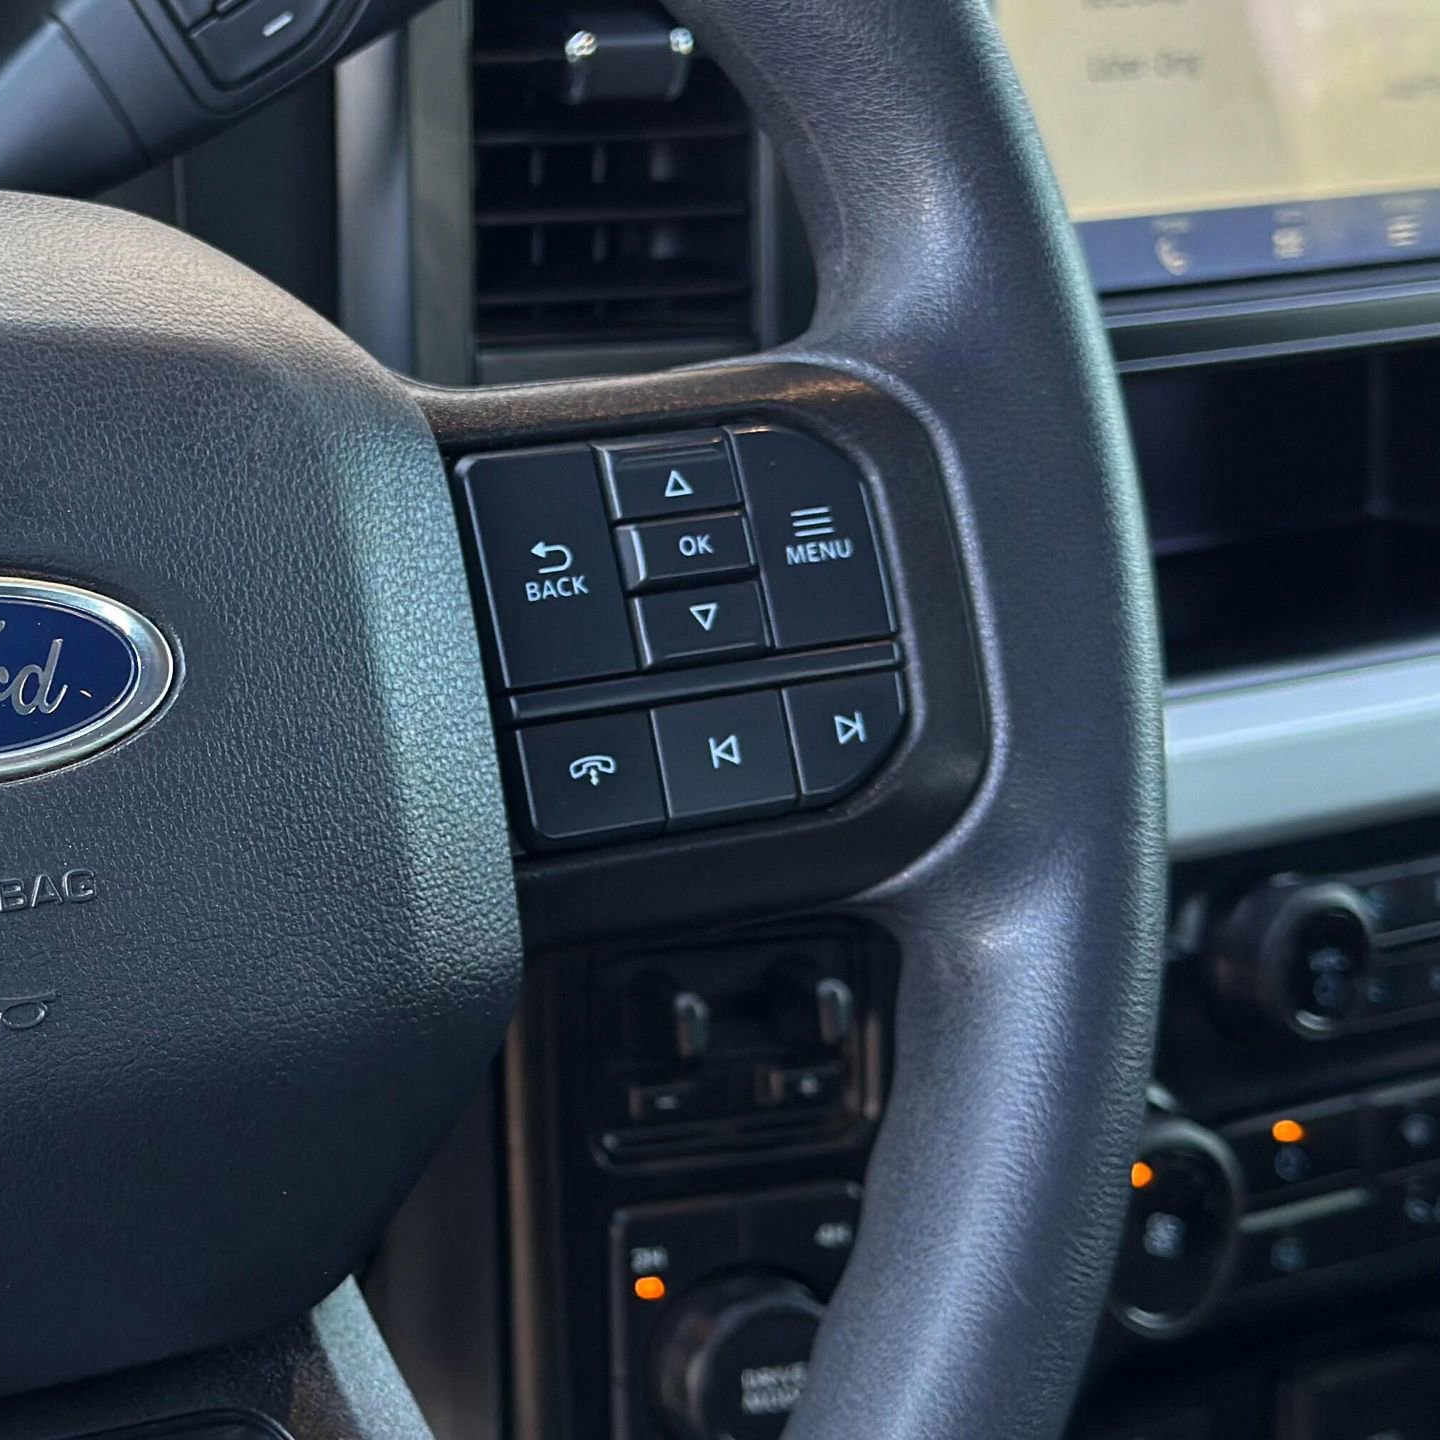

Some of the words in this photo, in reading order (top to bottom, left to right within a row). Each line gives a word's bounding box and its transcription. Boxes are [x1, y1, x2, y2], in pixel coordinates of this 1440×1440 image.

[679, 533, 715, 557] OK
[785, 537, 853, 566] MENU
[525, 575, 590, 604] BACK
